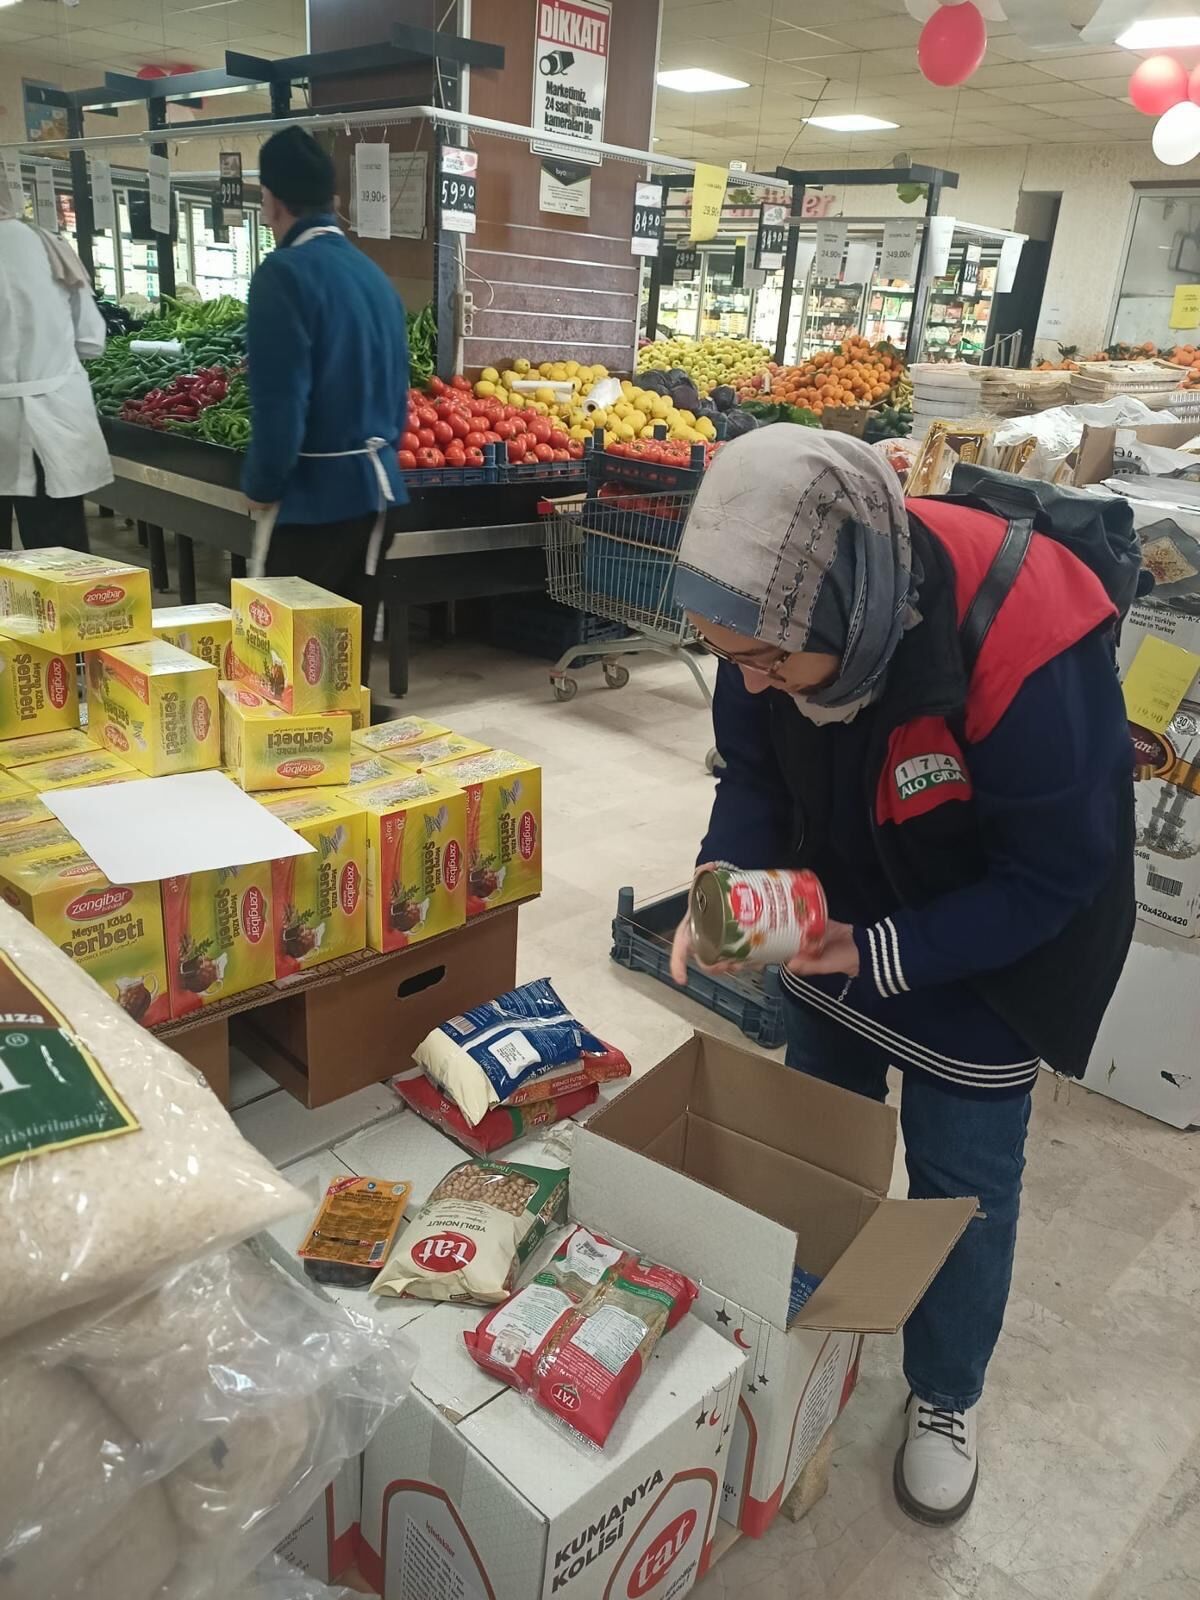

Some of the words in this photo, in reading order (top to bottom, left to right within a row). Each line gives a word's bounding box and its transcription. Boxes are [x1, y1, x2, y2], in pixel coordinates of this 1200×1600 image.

[540, 1, 606, 53] DİKKAT!
[545, 96, 555, 111] 24
[1129, 619, 1147, 628] Made
[1155, 624, 1176, 635] Turkey
[13, 654, 37, 720] Şerbeti
[901, 777, 927, 800] ALO
[930, 770, 966, 784] GIDA
[523, 815, 533, 855] zengibar
[448, 844, 458, 884] zengibar
[346, 865, 354, 909] zengibar
[72, 890, 129, 915] zengibar
[249, 890, 260, 938] zengibar
[72, 921, 105, 939] Meyan
[107, 912, 133, 929] Kökü
[534, 1114, 547, 1126] TAT
[427, 1221, 459, 1229] NOHUT
[460, 1221, 486, 1233] YERLİ
[419, 1238, 470, 1264] tat
[553, 1388, 578, 1408] TAT
[554, 1469, 664, 1569] KUMANYA
[552, 1516, 625, 1593] KOLİSİ
[638, 1518, 690, 1588] tat
